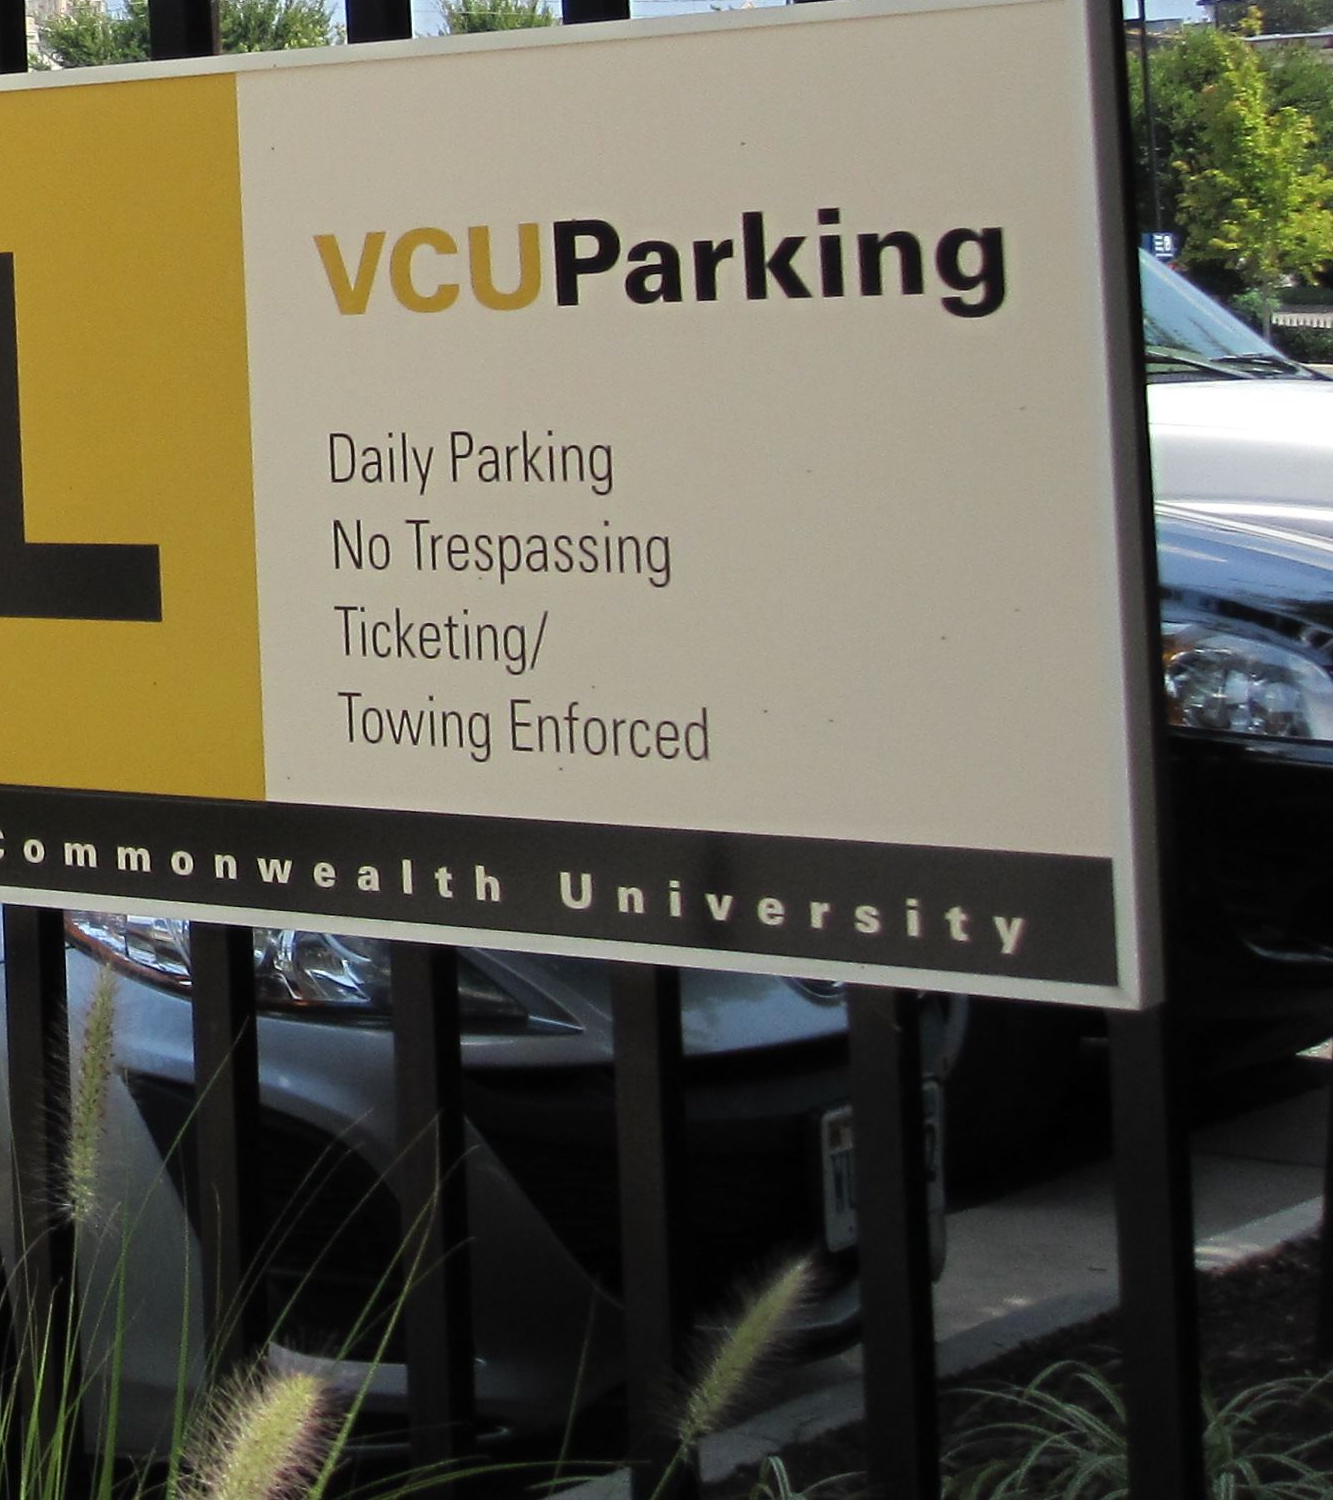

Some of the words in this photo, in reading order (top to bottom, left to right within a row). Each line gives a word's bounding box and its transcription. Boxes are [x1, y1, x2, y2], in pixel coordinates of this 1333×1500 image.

[330, 432, 433, 495] Daily
[449, 431, 613, 495] Parking
[333, 520, 391, 571] No
[405, 520, 671, 588] Trespassing
[334, 606, 549, 675] Ticketing/
[338, 692, 491, 762] Towing
[510, 699, 709, 761] Enforced
[560, 872, 1025, 955] University
